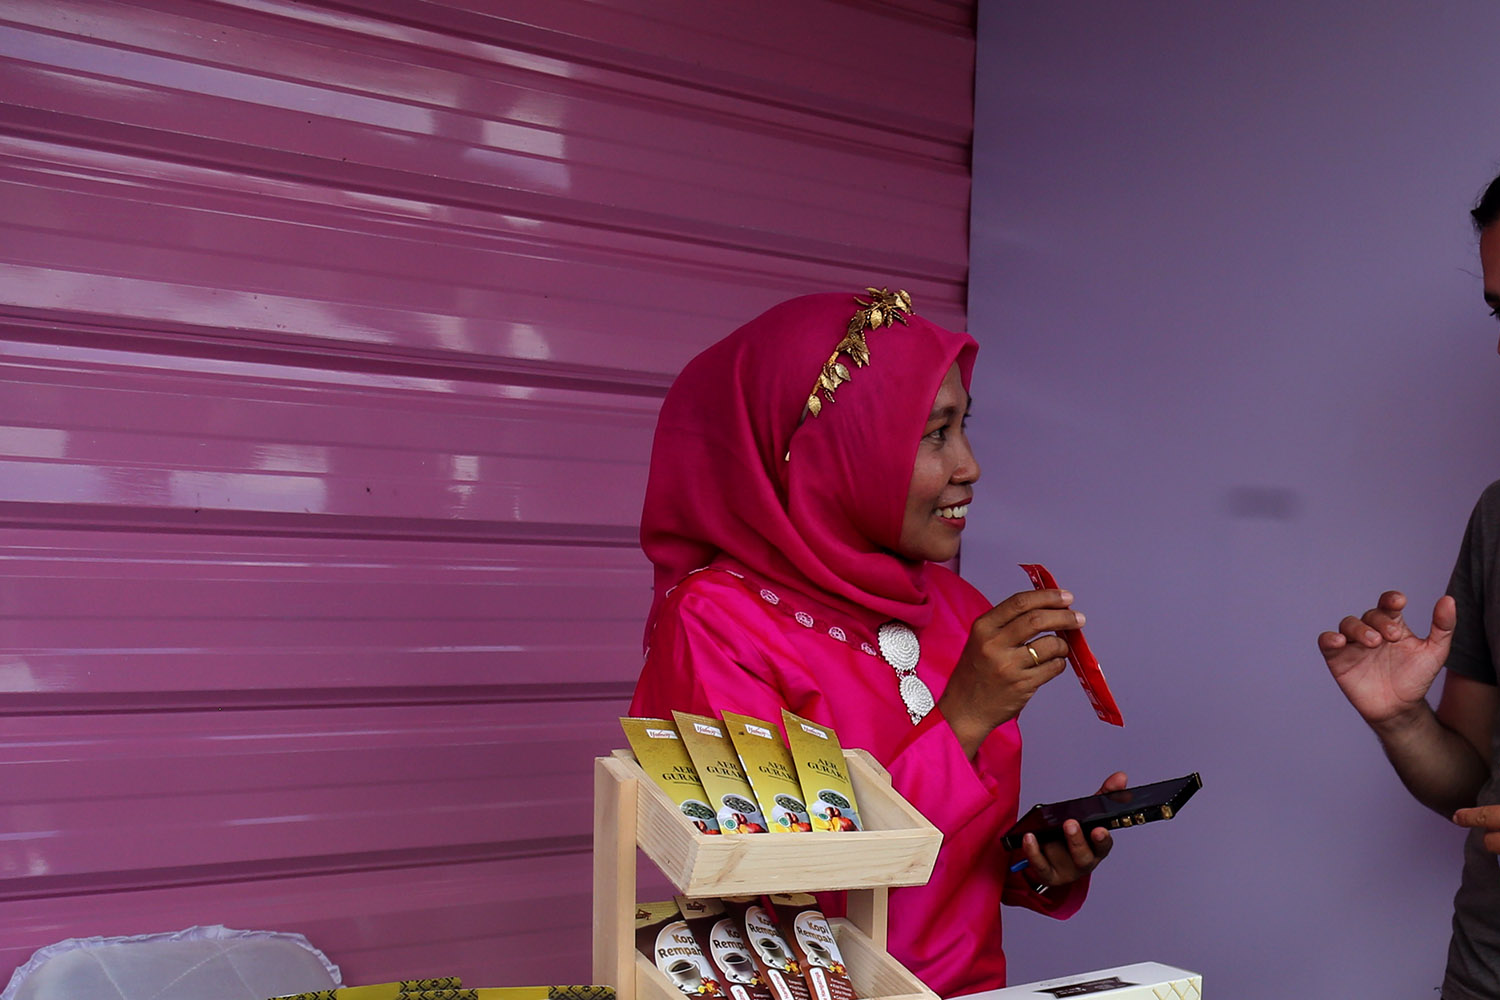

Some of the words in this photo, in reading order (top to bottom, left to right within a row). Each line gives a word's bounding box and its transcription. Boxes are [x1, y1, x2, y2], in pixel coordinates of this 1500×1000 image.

[717, 760, 738, 770] AER
[768, 761, 787, 771] AER
[818, 758, 837, 769] AER
[706, 766, 745, 779] GURAK
[806, 920, 829, 934] Kopi
[796, 926, 834, 944] Rempah
[712, 939, 745, 950] Rempa
